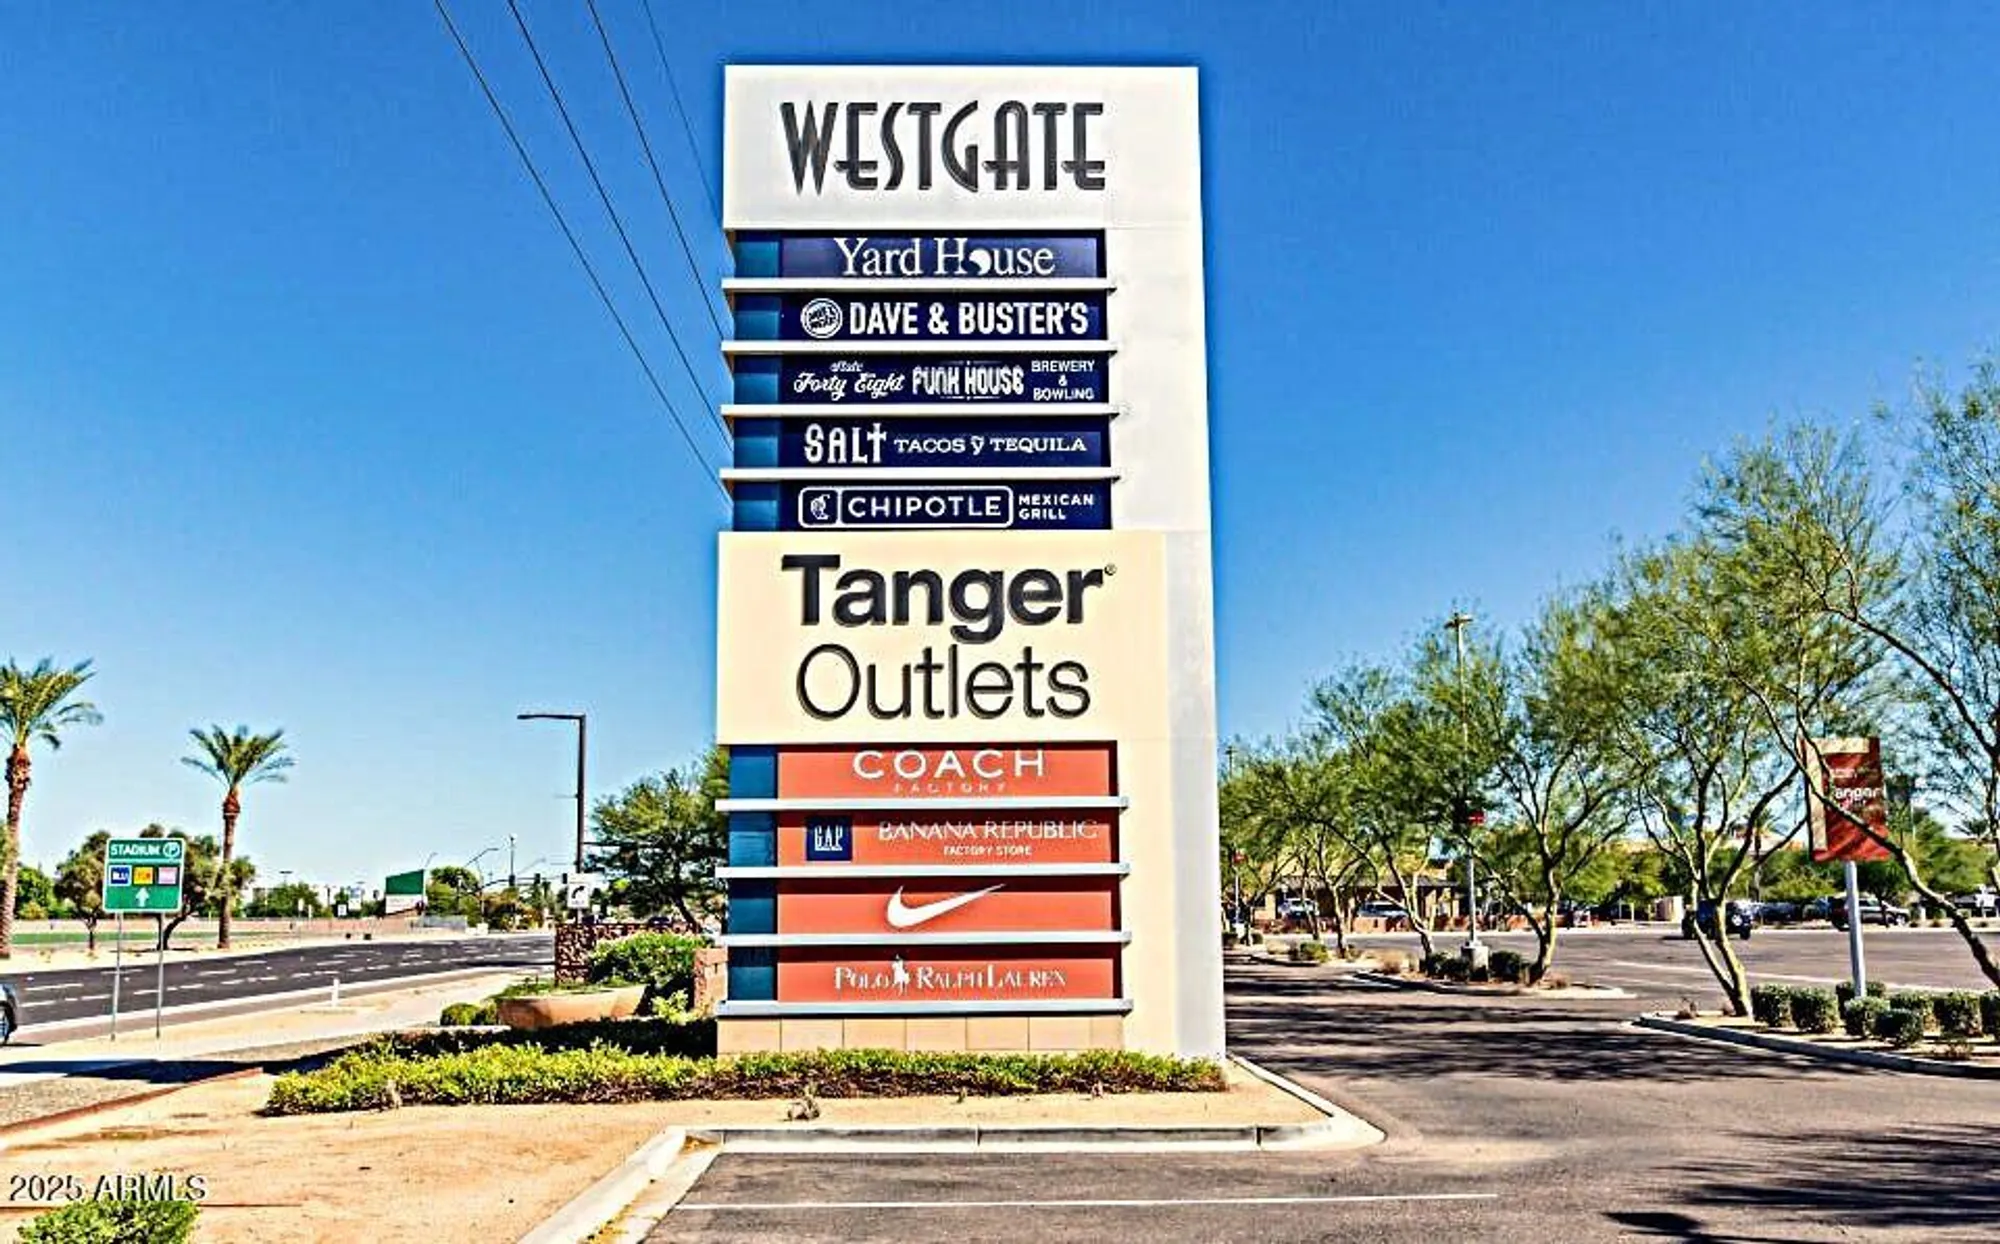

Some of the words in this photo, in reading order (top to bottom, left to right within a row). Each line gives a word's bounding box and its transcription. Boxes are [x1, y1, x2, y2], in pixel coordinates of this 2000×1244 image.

[780, 100, 1106, 196] WESTGATE
[834, 237, 923, 276] Yard
[934, 237, 1056, 276] House
[850, 302, 918, 335] DAVE
[928, 302, 949, 335] &
[958, 302, 1089, 335] BUSTER'S
[1031, 360, 1095, 373] BREWERY
[793, 372, 848, 400] Forty
[854, 373, 906, 399] Eight
[965, 366, 1024, 395] HOUSE
[1058, 374, 1069, 387] &
[1032, 387, 1095, 401] BOWLING
[804, 422, 887, 464] SALT
[894, 438, 966, 453] TACOS
[990, 438, 1088, 454] TEQUILA
[848, 496, 1002, 518] CHIPOTLE
[1018, 493, 1094, 506] MEXICAN
[1018, 508, 1067, 520] GRILL
[796, 643, 1090, 720] Outlets
[853, 749, 1044, 778] COACH
[814, 825, 843, 851] GAP
[878, 822, 977, 841] BANANA
[983, 820, 1098, 839] REPUBLIC
[110, 843, 161, 856] STADIUM
[943, 845, 992, 856] FACTORY
[996, 844, 1032, 855] STORE
